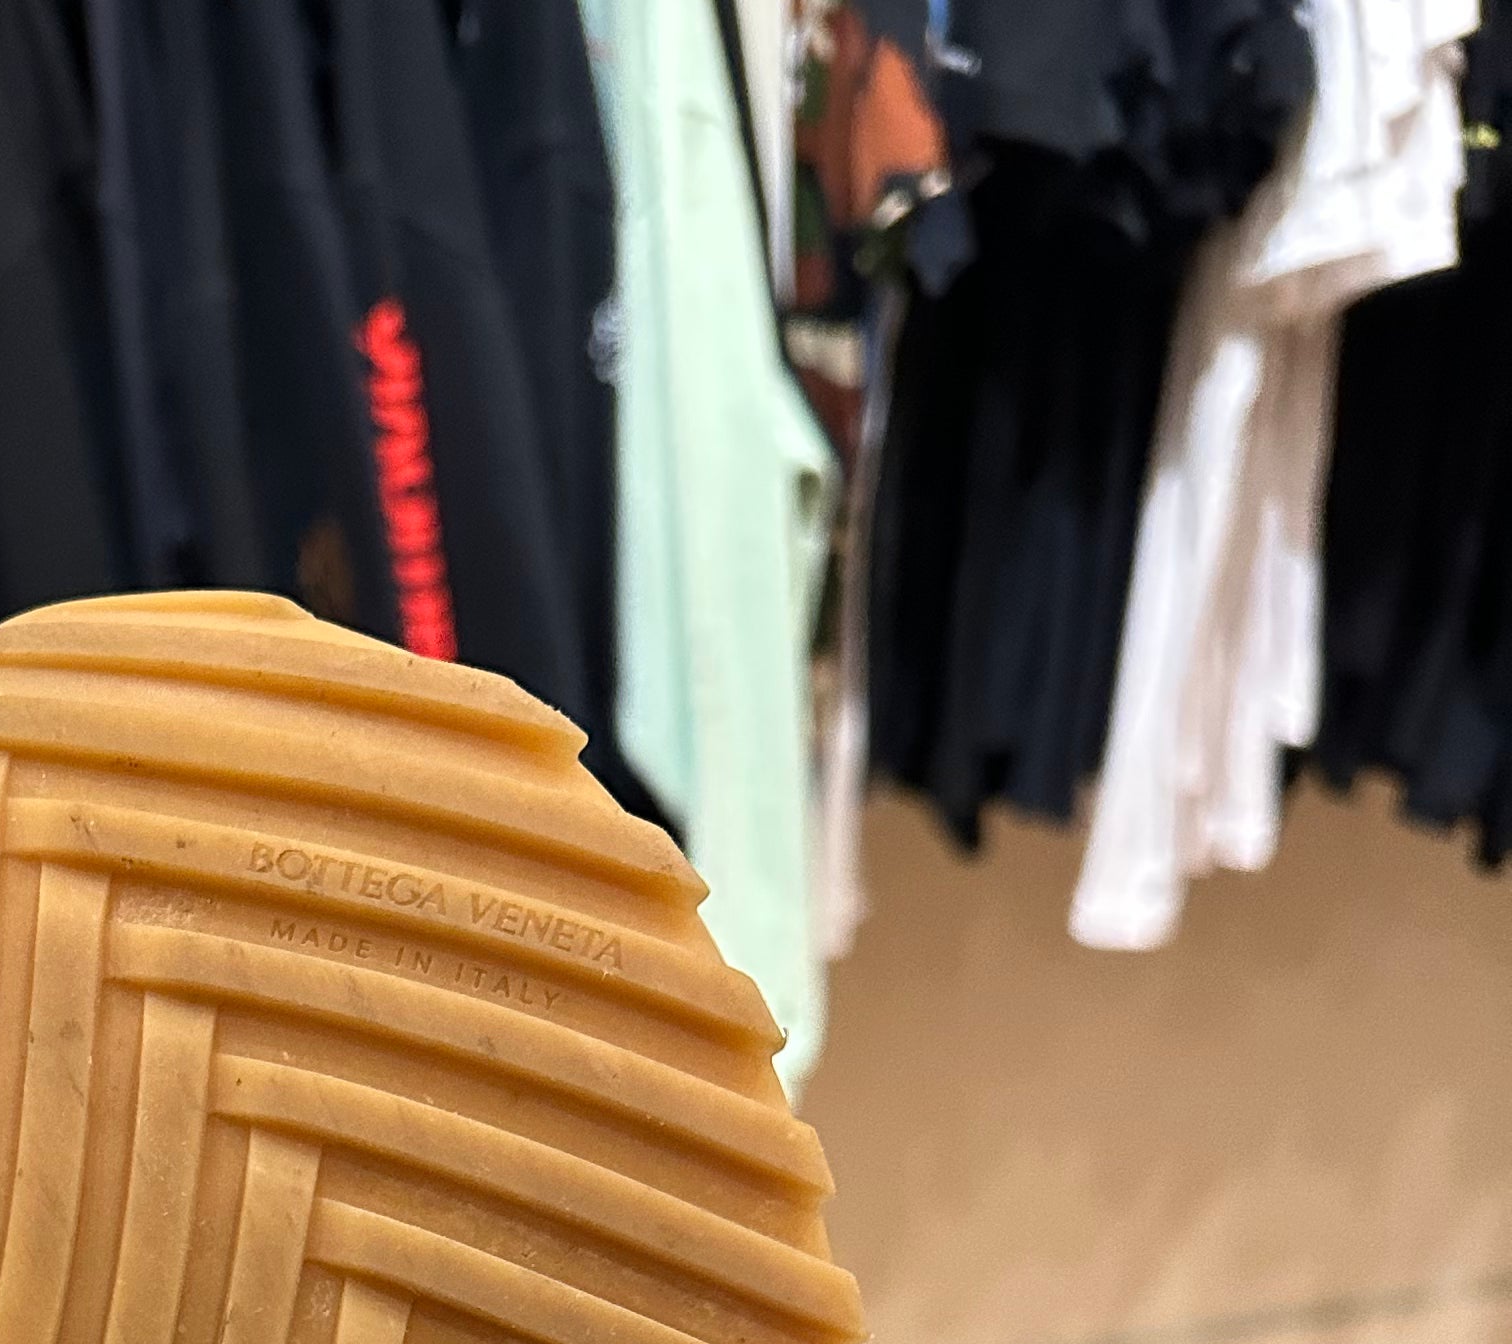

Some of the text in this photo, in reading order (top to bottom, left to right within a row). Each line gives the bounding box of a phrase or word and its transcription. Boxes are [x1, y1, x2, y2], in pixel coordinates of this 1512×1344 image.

[248, 841, 624, 971] BOTTEGA VENETA
[270, 917, 565, 1011] MADE IN ITALY
